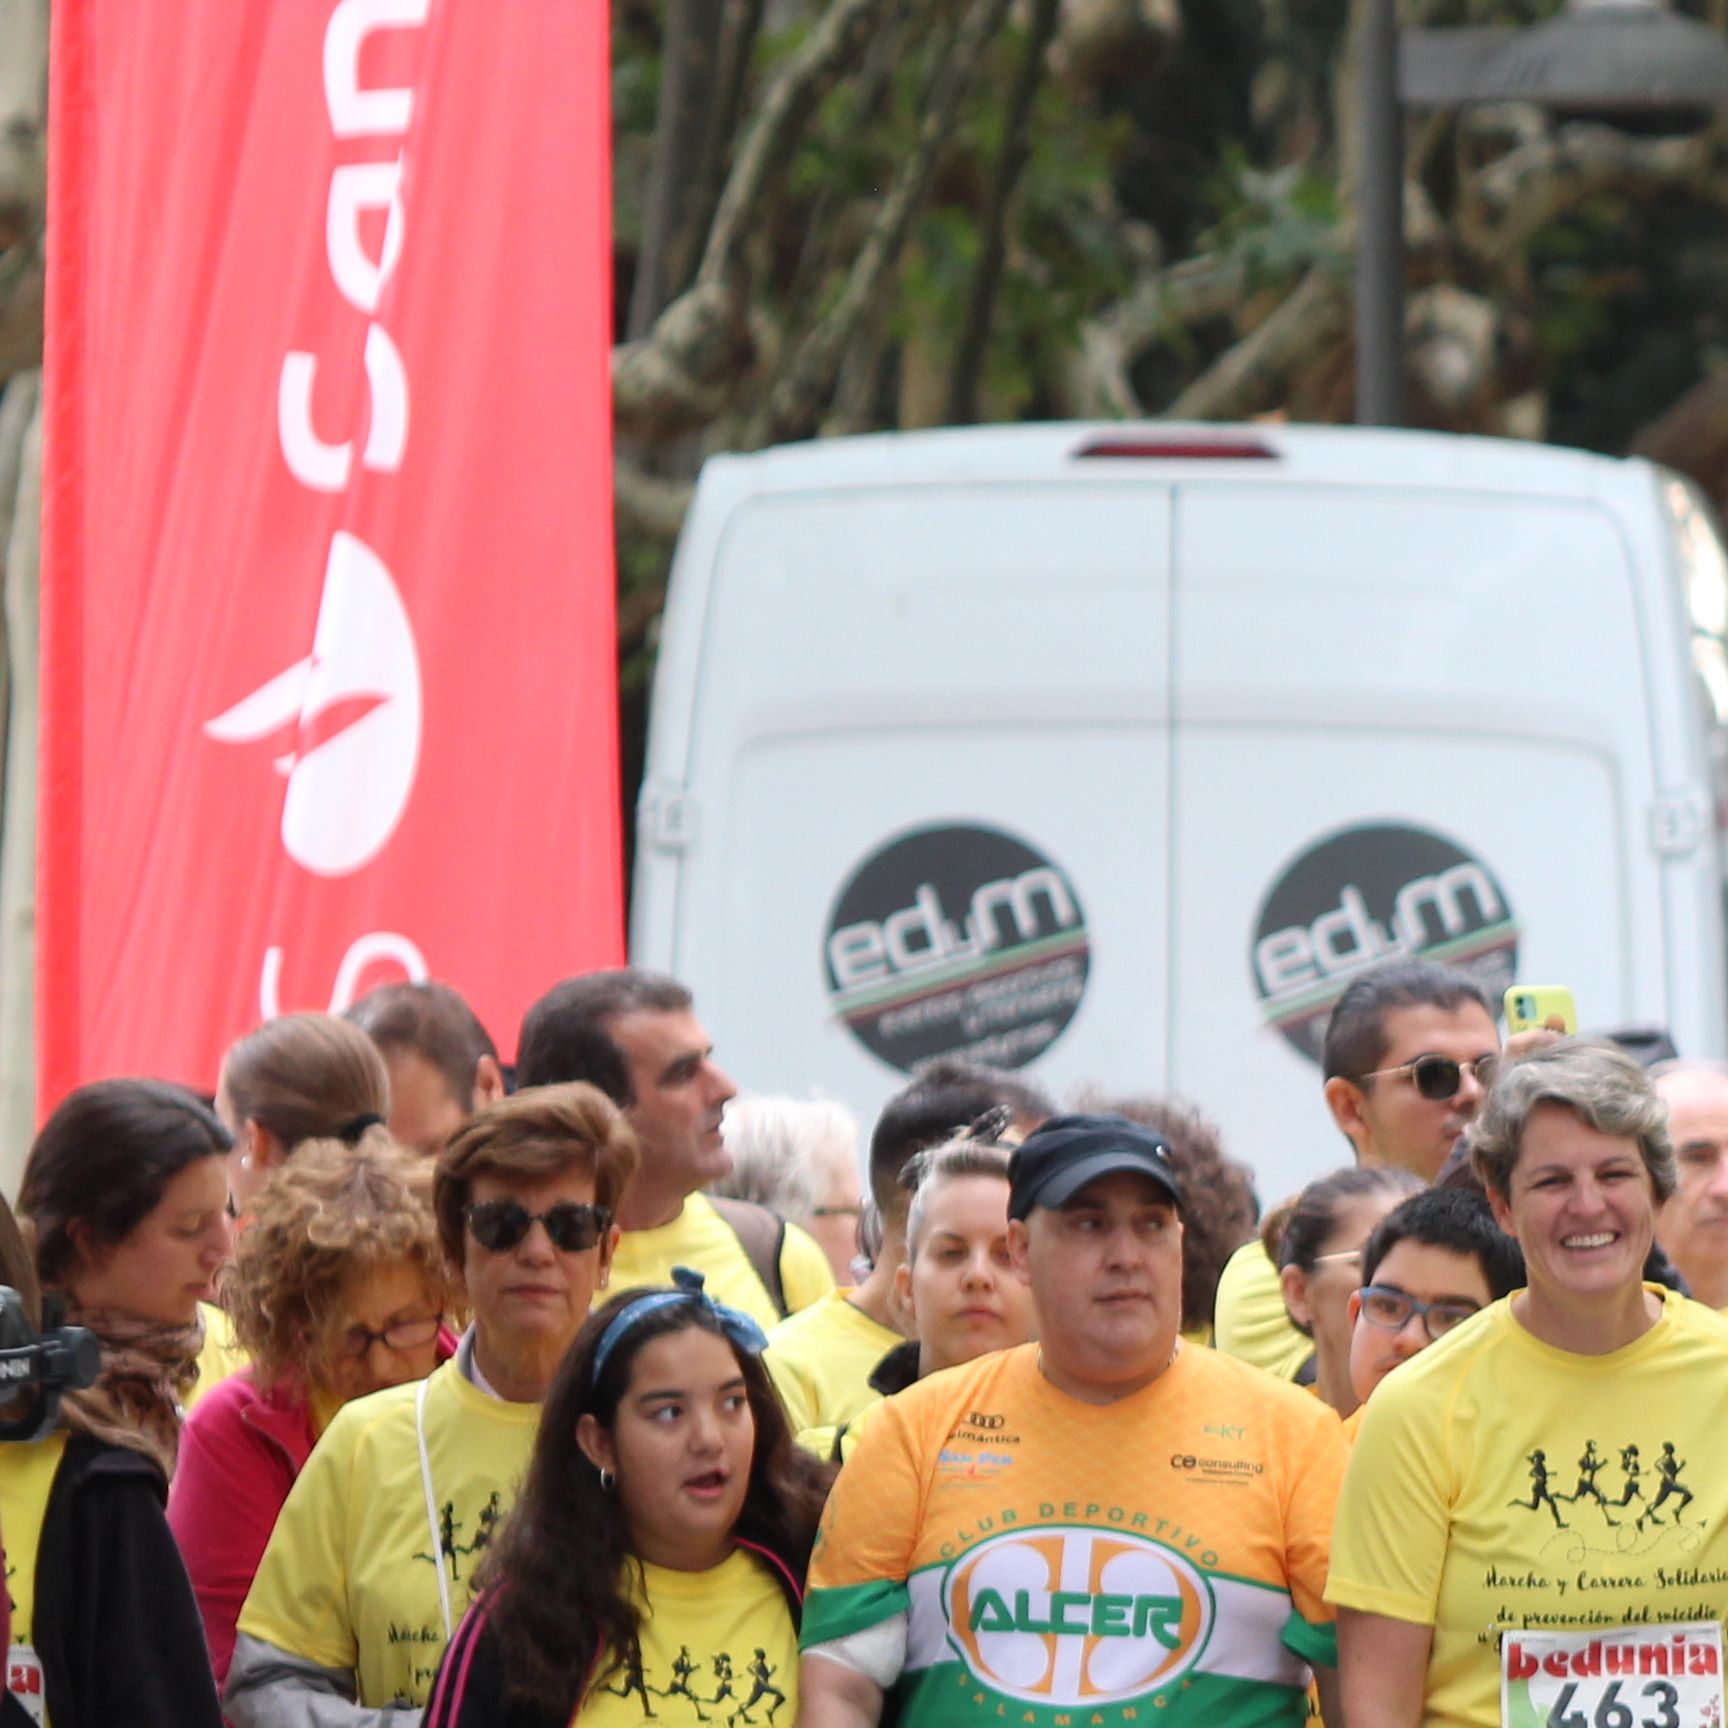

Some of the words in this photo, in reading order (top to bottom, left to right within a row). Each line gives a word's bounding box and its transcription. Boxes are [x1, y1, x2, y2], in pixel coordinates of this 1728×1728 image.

[939, 1508, 1018, 1558] CLUB
[1038, 1502, 1220, 1568] DEPORTIVO
[1483, 1565, 1550, 1590] Marcha
[1557, 1579, 1568, 1596] y
[1576, 1570, 1646, 1592] Carrera
[967, 1586, 1185, 1652] ALCER
[1496, 1605, 1516, 1623] de
[1522, 1609, 1615, 1629] prevención
[1621, 1606, 1651, 1624] del
[1656, 1603, 1718, 1622] suicidio
[1507, 1634, 1719, 1681] bedunia
